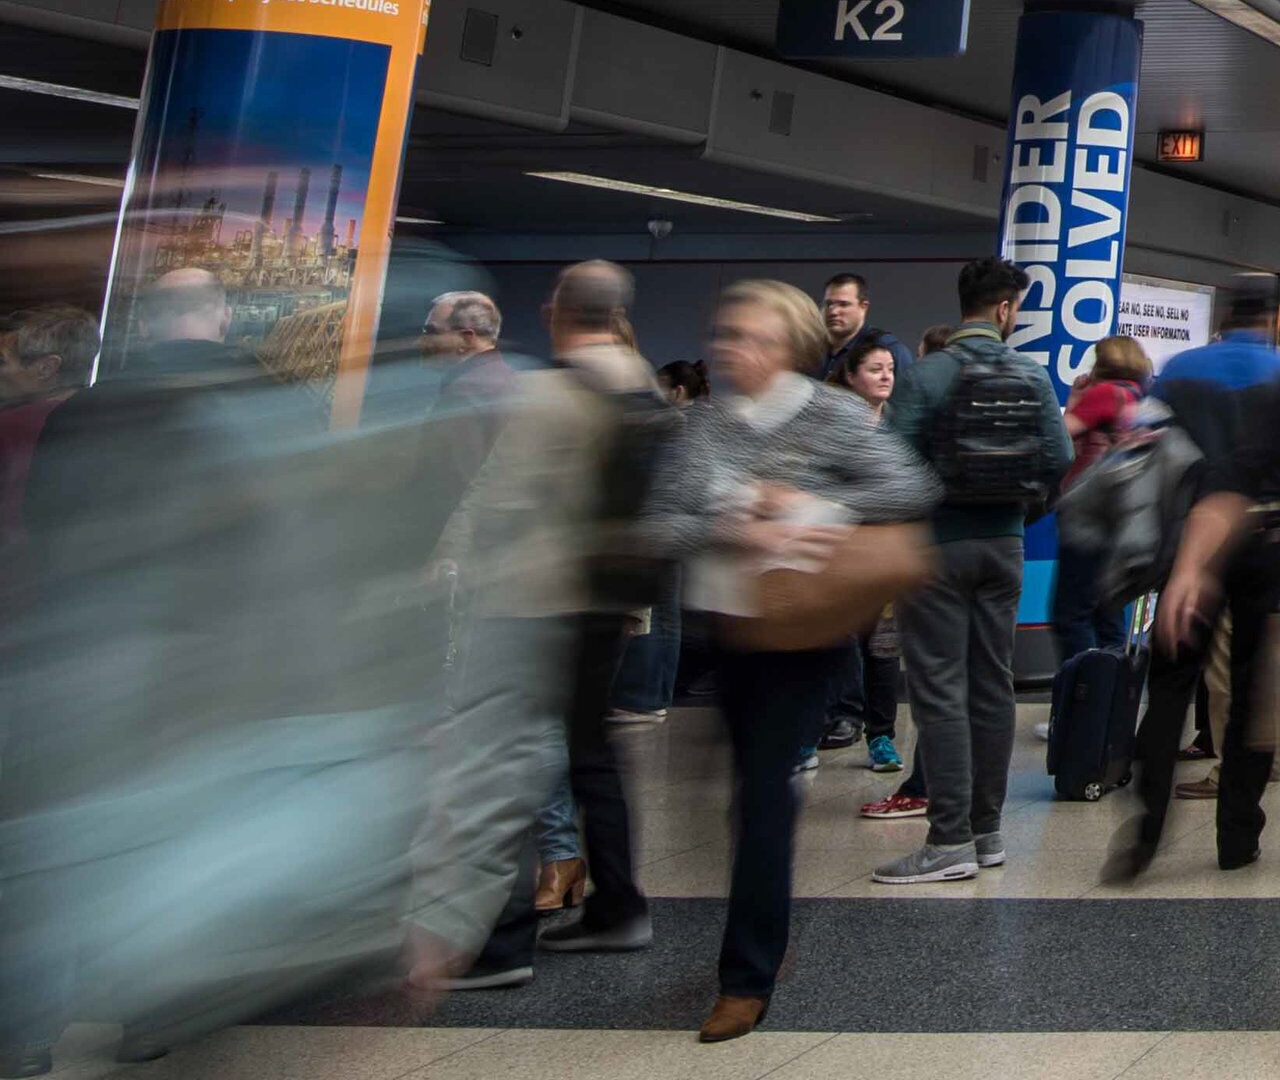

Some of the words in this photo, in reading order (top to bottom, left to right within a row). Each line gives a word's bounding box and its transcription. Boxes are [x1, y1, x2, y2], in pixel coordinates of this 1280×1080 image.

[834, 0, 904, 41] K2
[1161, 133, 1198, 155] EXIT
[1143, 304, 1154, 317] SEE
[1166, 307, 1179, 320] SELL
[1133, 324, 1150, 338] USER
